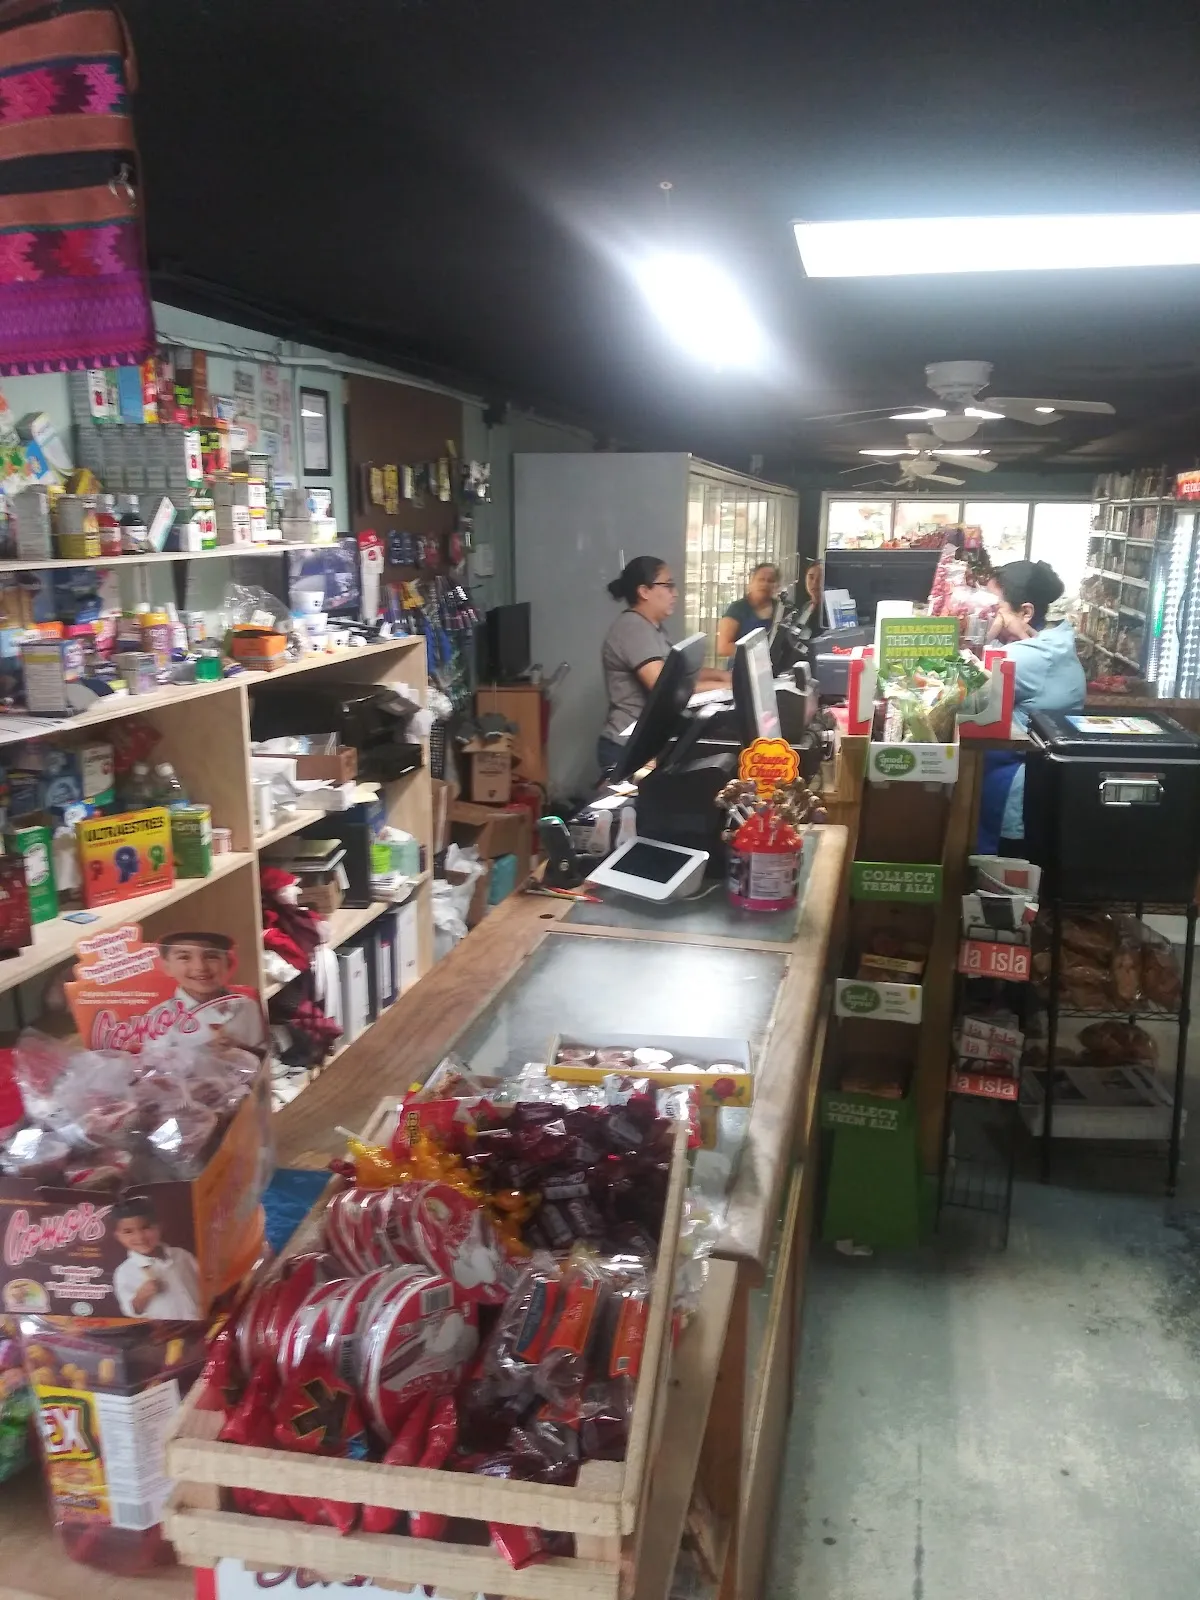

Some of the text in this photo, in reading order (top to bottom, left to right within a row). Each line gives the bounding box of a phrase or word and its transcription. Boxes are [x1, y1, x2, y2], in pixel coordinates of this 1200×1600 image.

[886, 625, 955, 634] CHARACTERS
[886, 634, 955, 648] THEY LOVE,
[885, 647, 954, 657] NUTRITION
[751, 753, 788, 767] Chupa
[750, 766, 788, 779] Chups
[862, 870, 936, 884] COLLECT
[862, 882, 902, 893] THEM
[963, 941, 1028, 974] la isla
[979, 1075, 1016, 1096] isla
